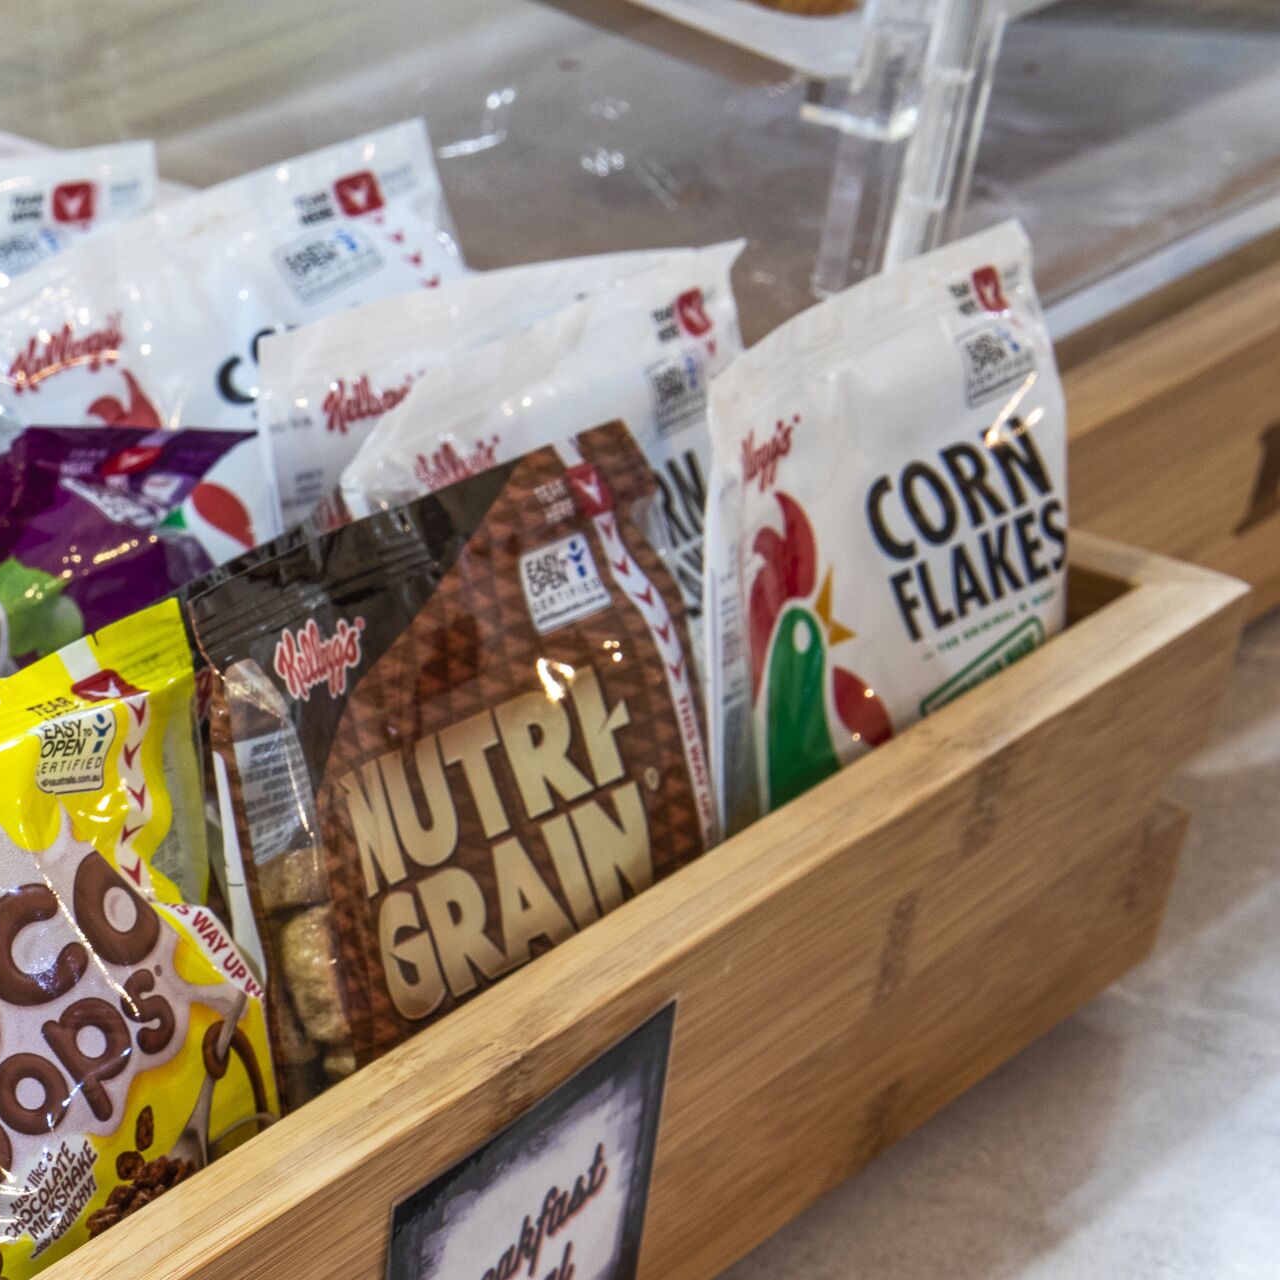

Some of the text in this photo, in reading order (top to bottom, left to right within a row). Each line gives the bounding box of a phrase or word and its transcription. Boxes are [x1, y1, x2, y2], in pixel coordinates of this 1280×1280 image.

[865, 417, 1053, 562] CORN
[889, 501, 1068, 642] FLAKES
[276, 620, 361, 700] Kellogg's
[27, 697, 72, 717] TEAR
[41, 739, 85, 757] OPEN
[44, 719, 82, 740] EASY
[379, 782, 653, 1020] GRAIN
[191, 911, 247, 980] WAY UP
[5, 1141, 76, 1237] CHOCOLATE
[28, 1140, 98, 1240] MILKSHAKE
